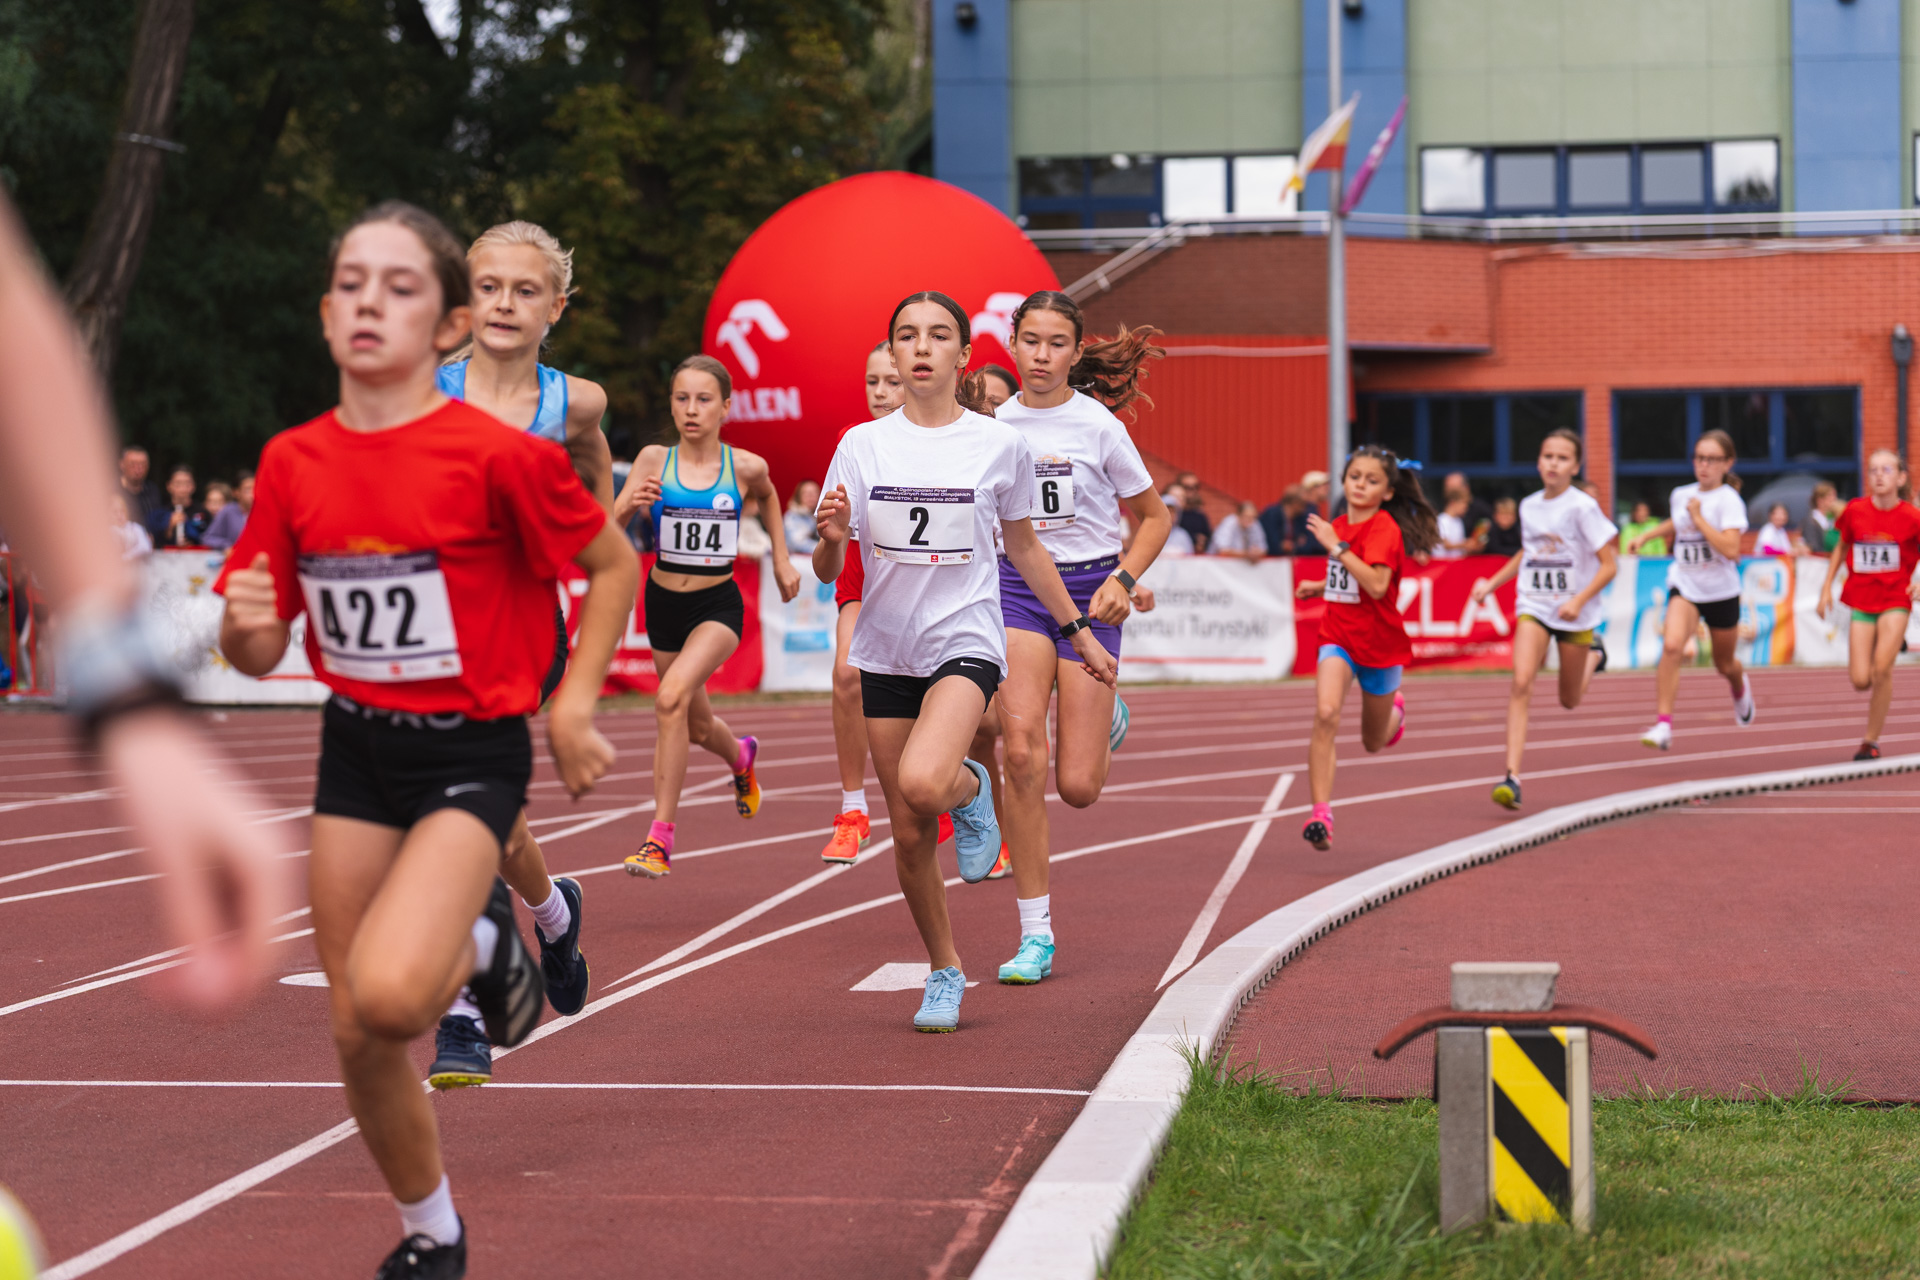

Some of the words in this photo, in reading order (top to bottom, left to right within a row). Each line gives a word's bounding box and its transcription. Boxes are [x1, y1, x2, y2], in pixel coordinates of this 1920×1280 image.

[722, 386, 802, 422] RLEN
[1042, 480, 1060, 514] 6
[673, 522, 722, 552] 184
[909, 507, 929, 546] 2
[1100, 559, 1115, 567] SPORT
[1863, 549, 1889, 564] 124
[1329, 565, 1348, 590] 53
[1532, 571, 1567, 590] 448
[320, 586, 426, 649] 422
